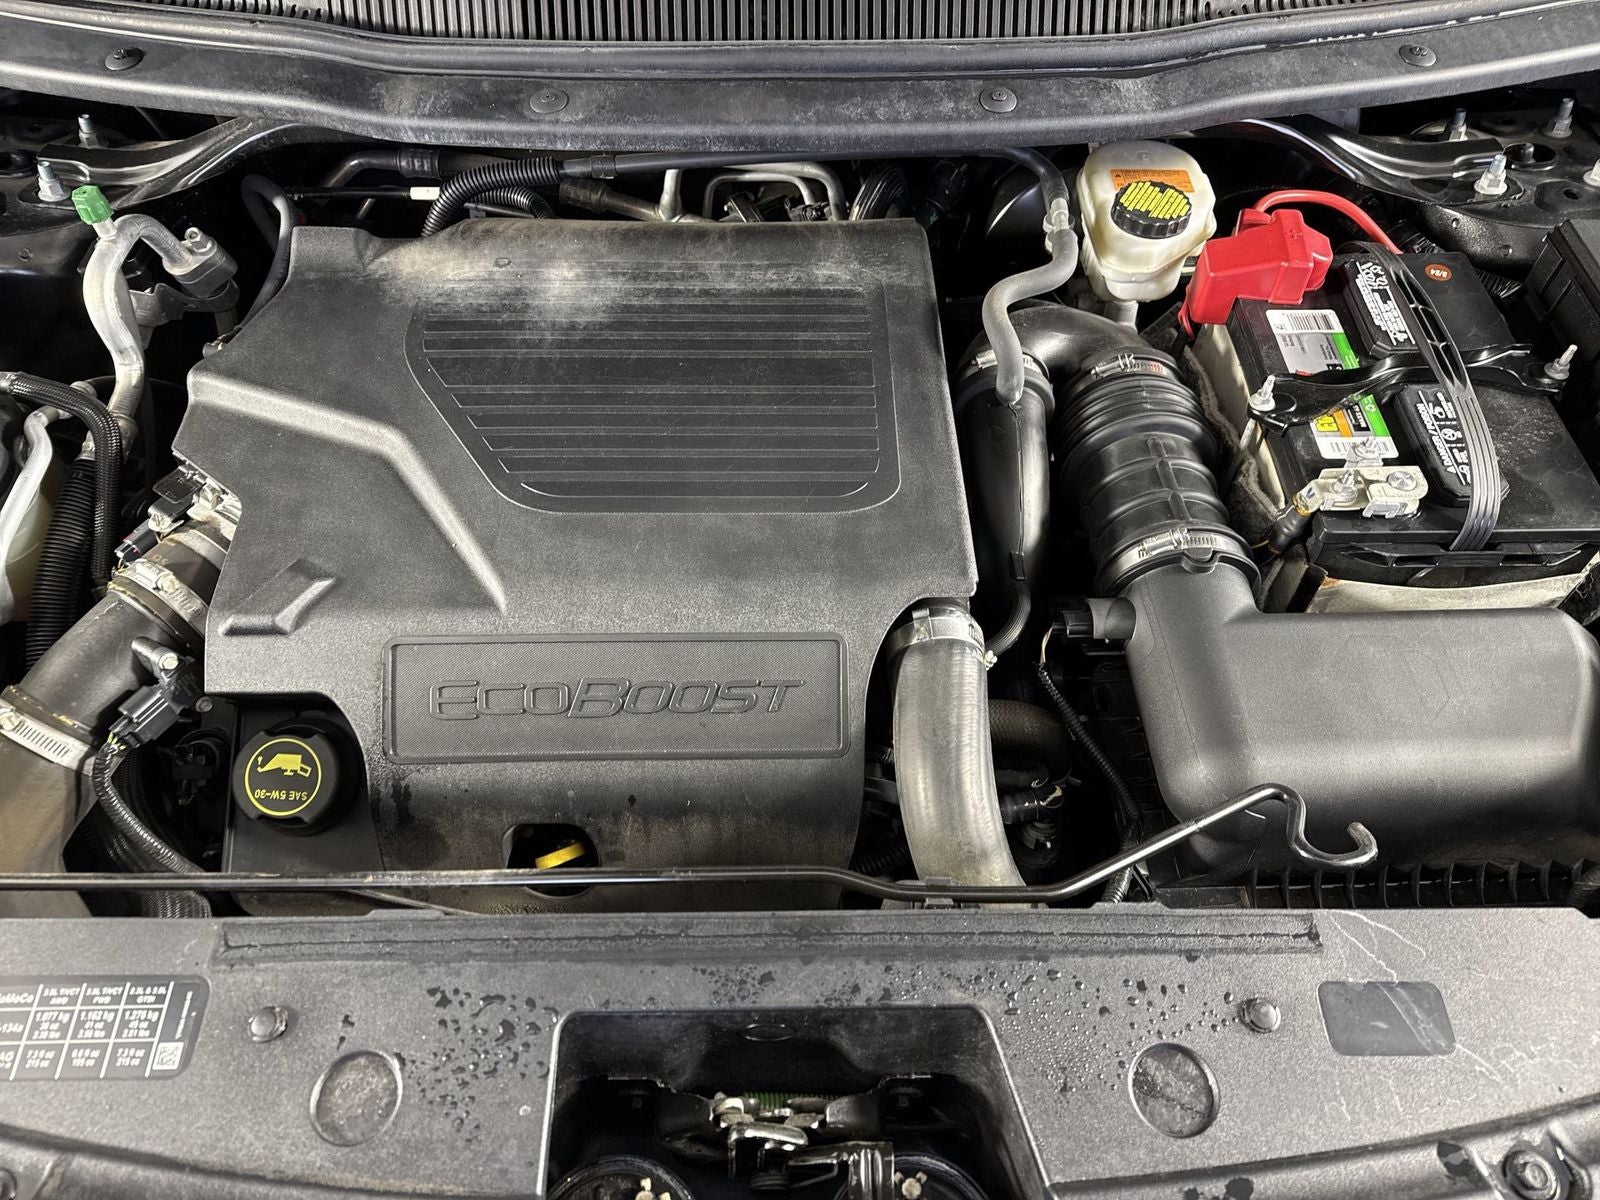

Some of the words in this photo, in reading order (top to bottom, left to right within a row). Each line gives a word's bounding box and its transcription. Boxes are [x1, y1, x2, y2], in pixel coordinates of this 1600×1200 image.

[1416, 403, 1435, 430] POISON
[1432, 436, 1453, 466] DANGER
[254, 788, 287, 800] 5W-30
[288, 790, 308, 801] SAE
[102, 1010, 115, 1023] kg
[146, 1009, 160, 1022] kg
